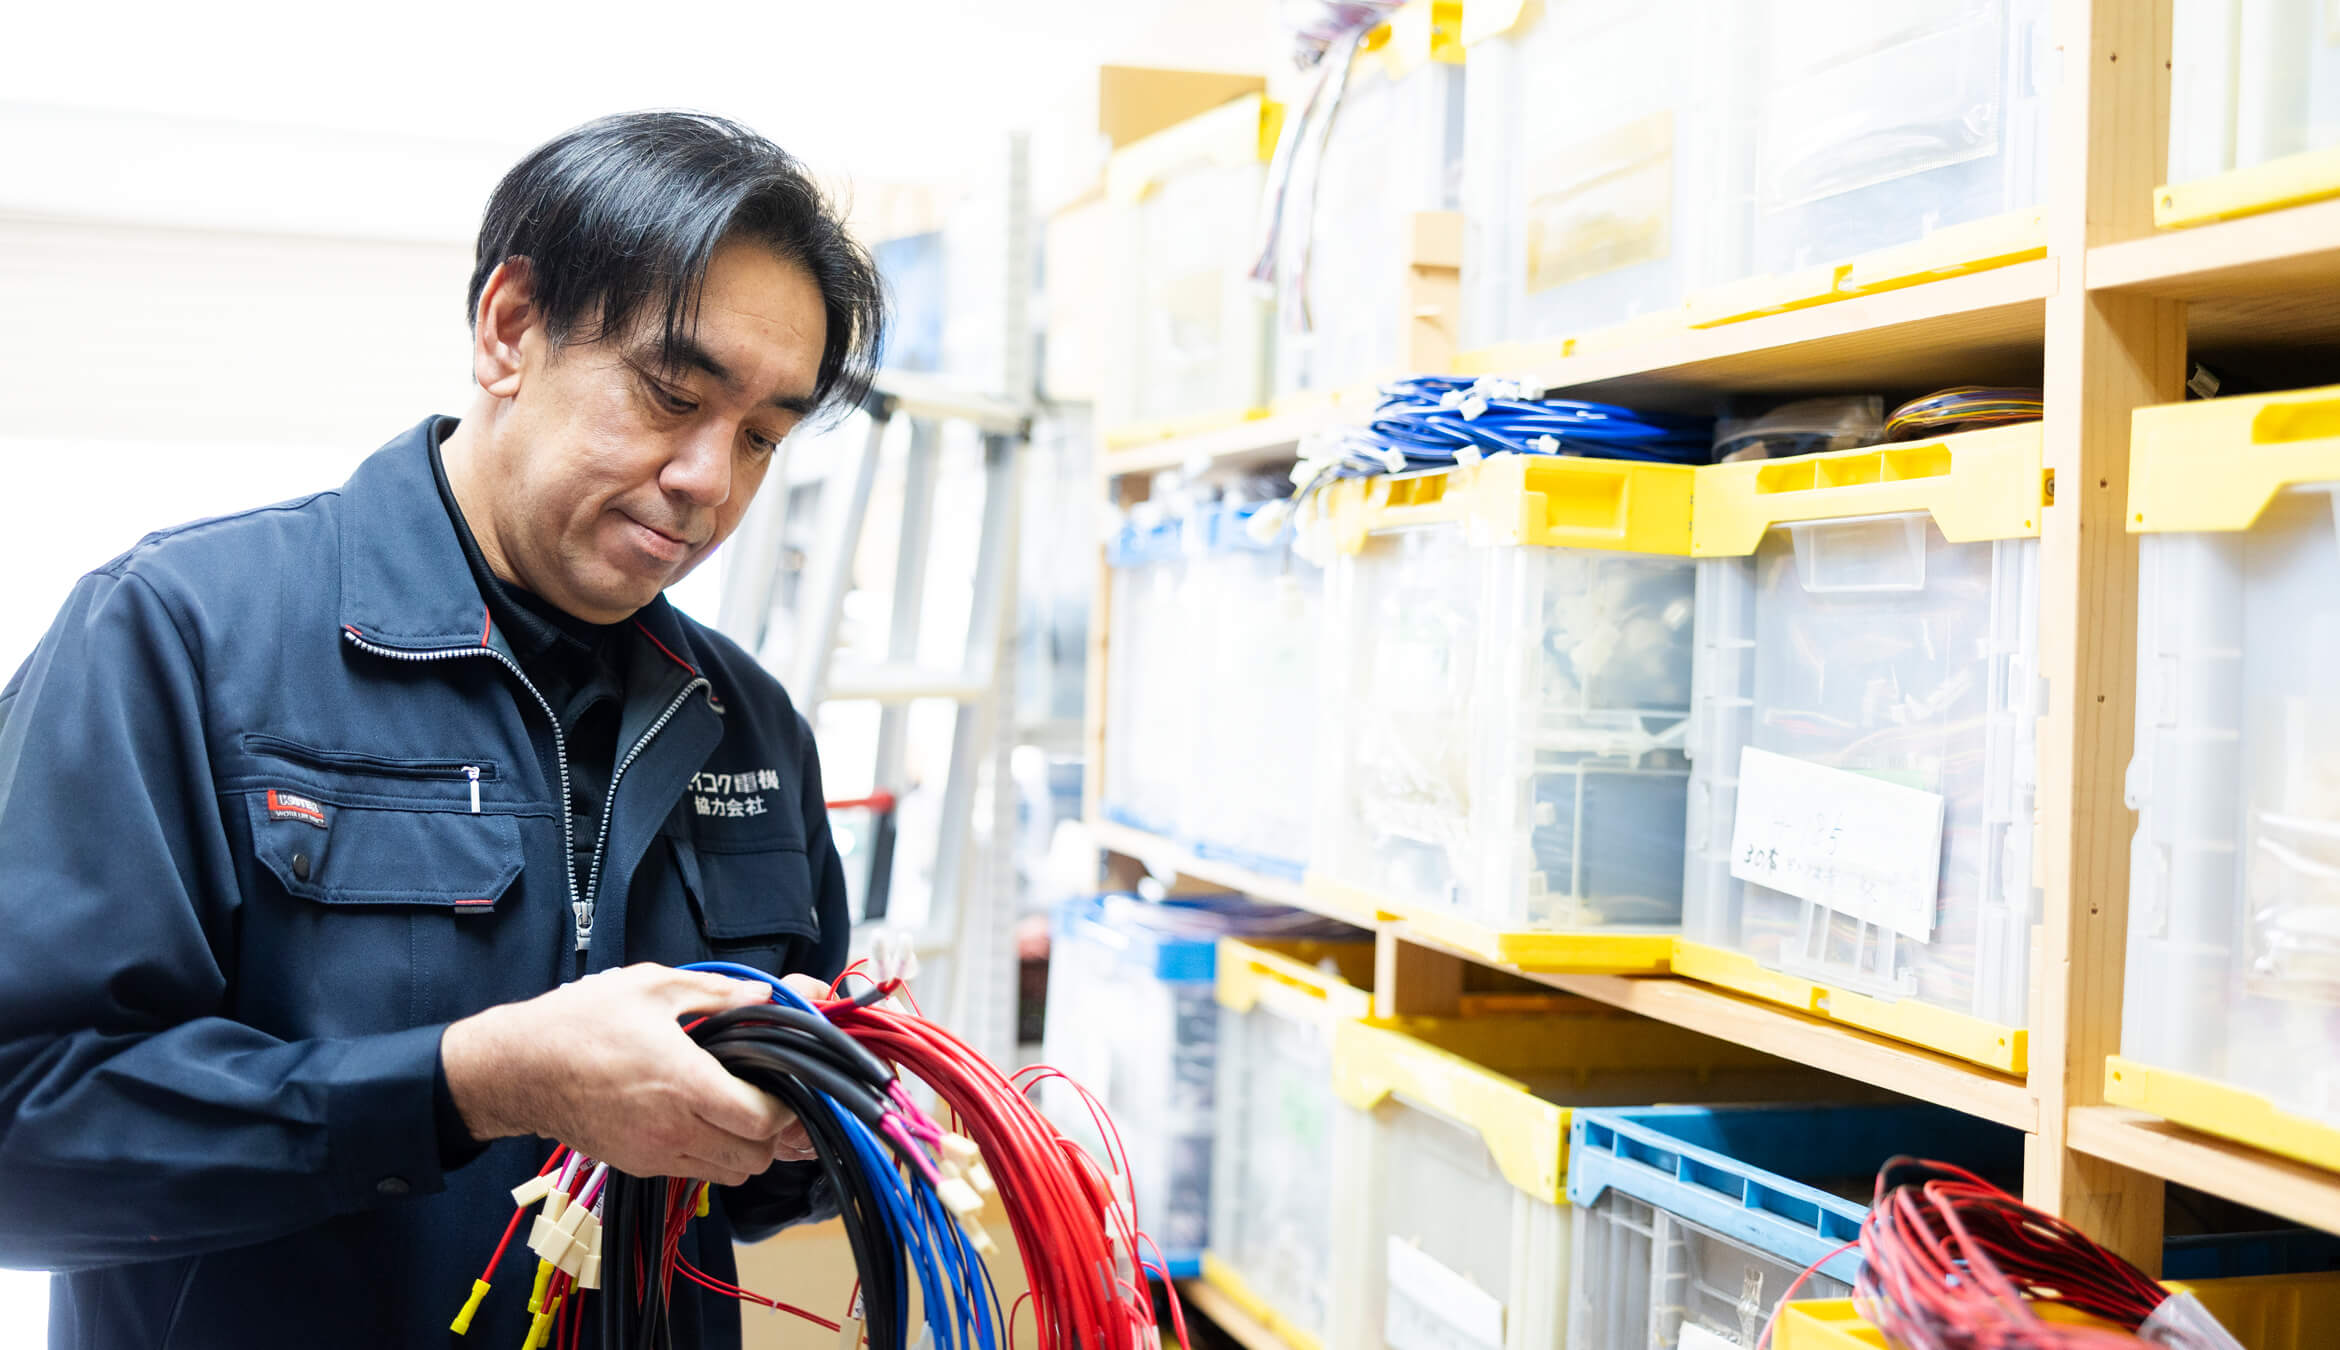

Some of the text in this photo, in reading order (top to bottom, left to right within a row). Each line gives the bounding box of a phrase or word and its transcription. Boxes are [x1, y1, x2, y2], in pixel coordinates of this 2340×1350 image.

[688, 769, 780, 795] イコク電機
[694, 795, 768, 817] 協力会社
